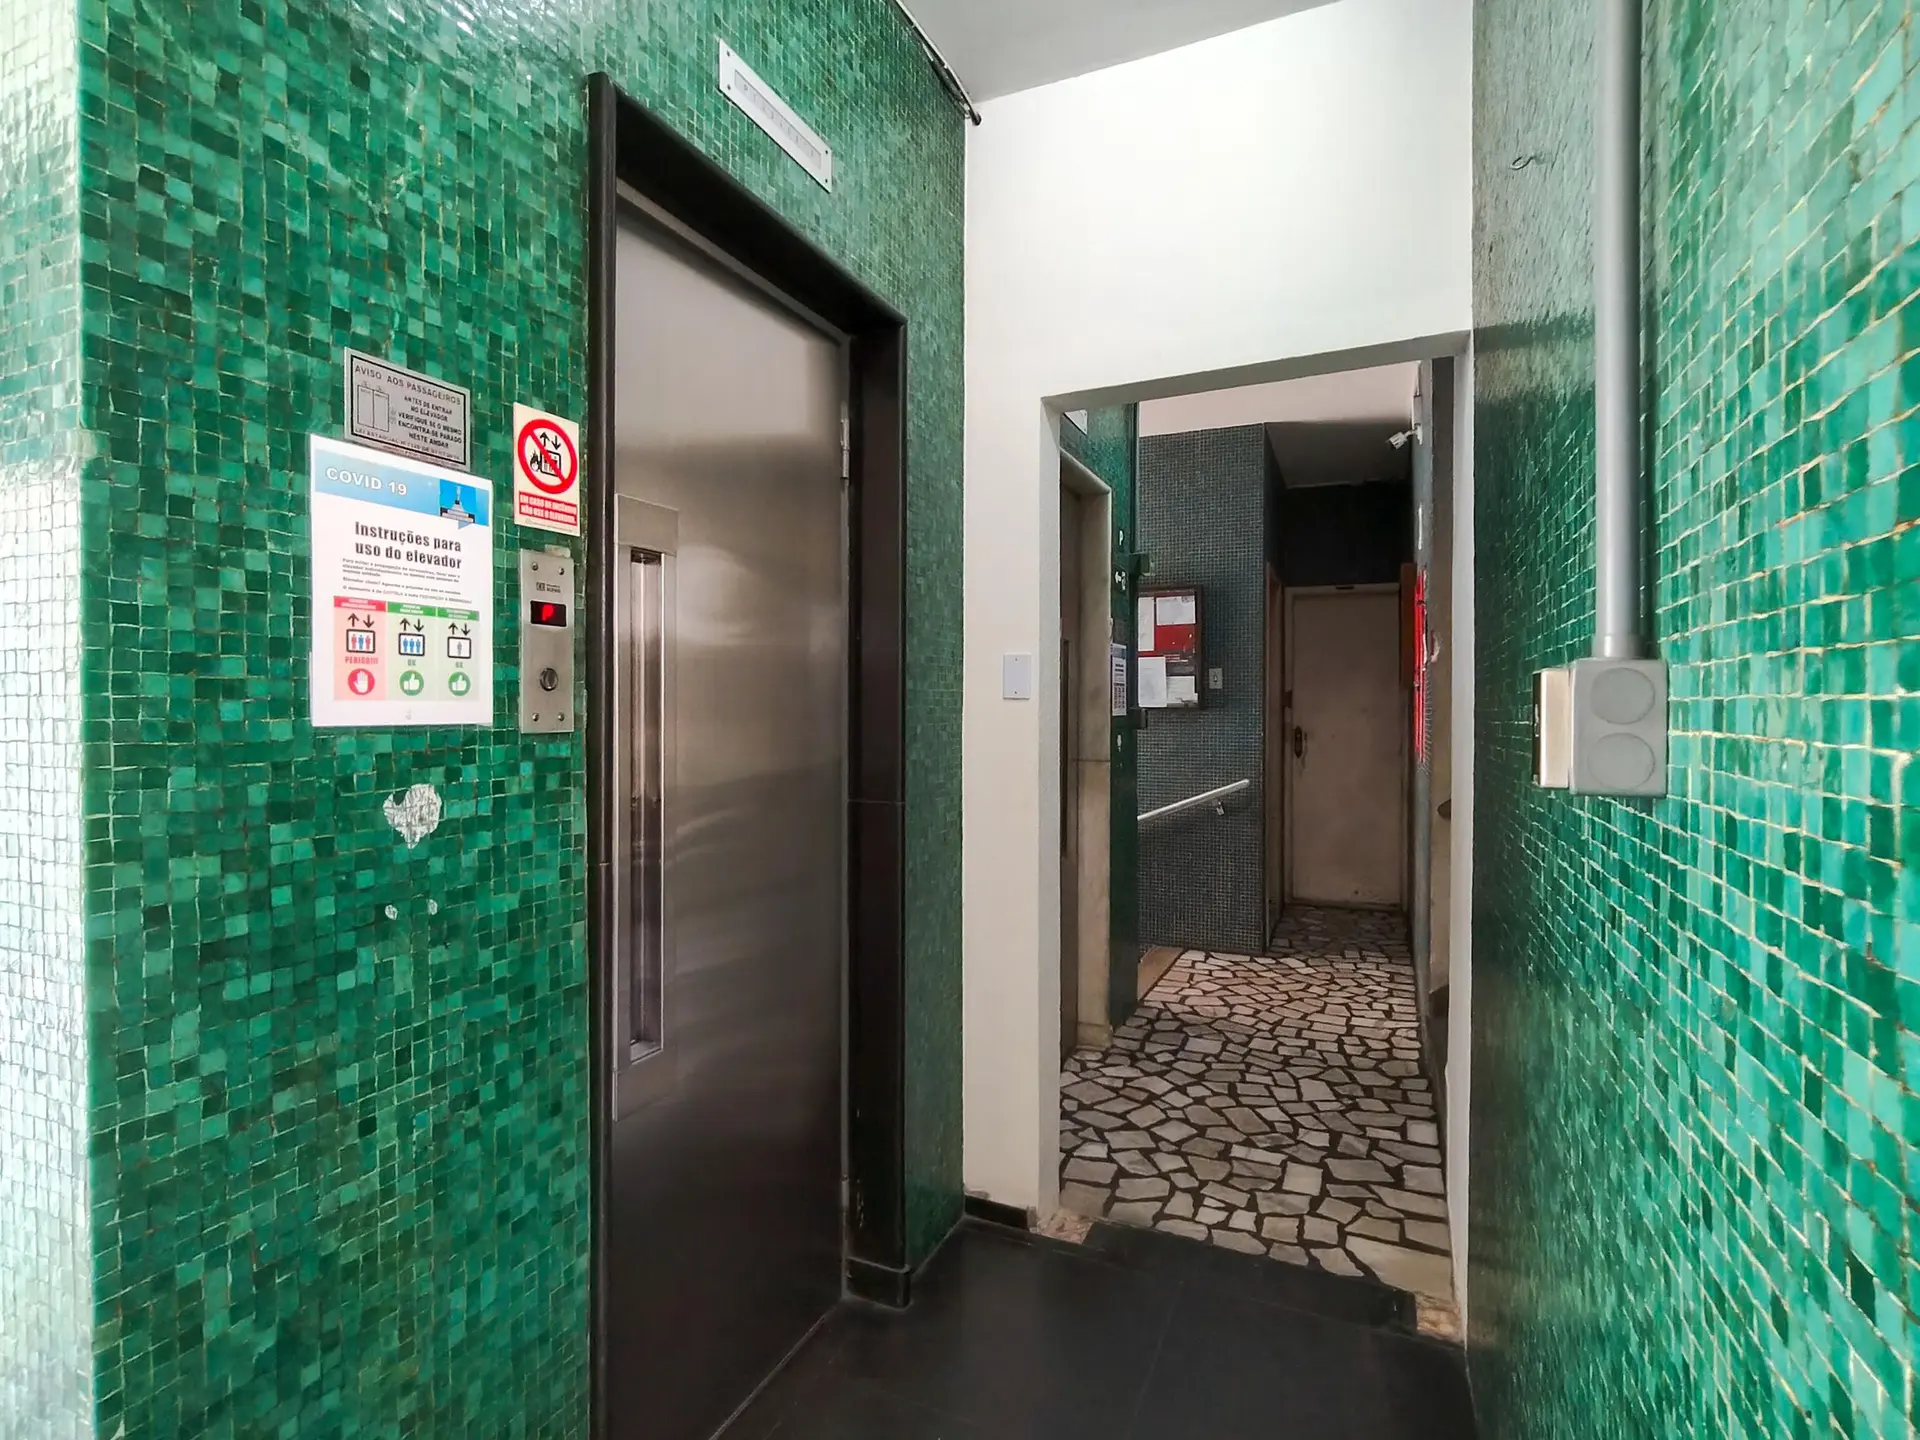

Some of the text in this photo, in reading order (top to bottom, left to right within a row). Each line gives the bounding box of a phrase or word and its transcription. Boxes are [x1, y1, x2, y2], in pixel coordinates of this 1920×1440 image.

[355, 365, 461, 406] AVISO AOS PASSAGEIROS
[404, 395, 452, 415] ANTES DE ENTRAR
[411, 406, 448, 422] NO ELEVADOR
[398, 412, 428, 425] VERIFIQUE
[429, 420, 436, 428] SE
[442, 424, 462, 436] MESMO
[408, 433, 449, 449] NESTE ANDAR
[440, 431, 462, 444] PARADO
[326, 467, 407, 496] COVID 19
[355, 521, 462, 553] Instruções para
[355, 542, 462, 569] uso do elevador
